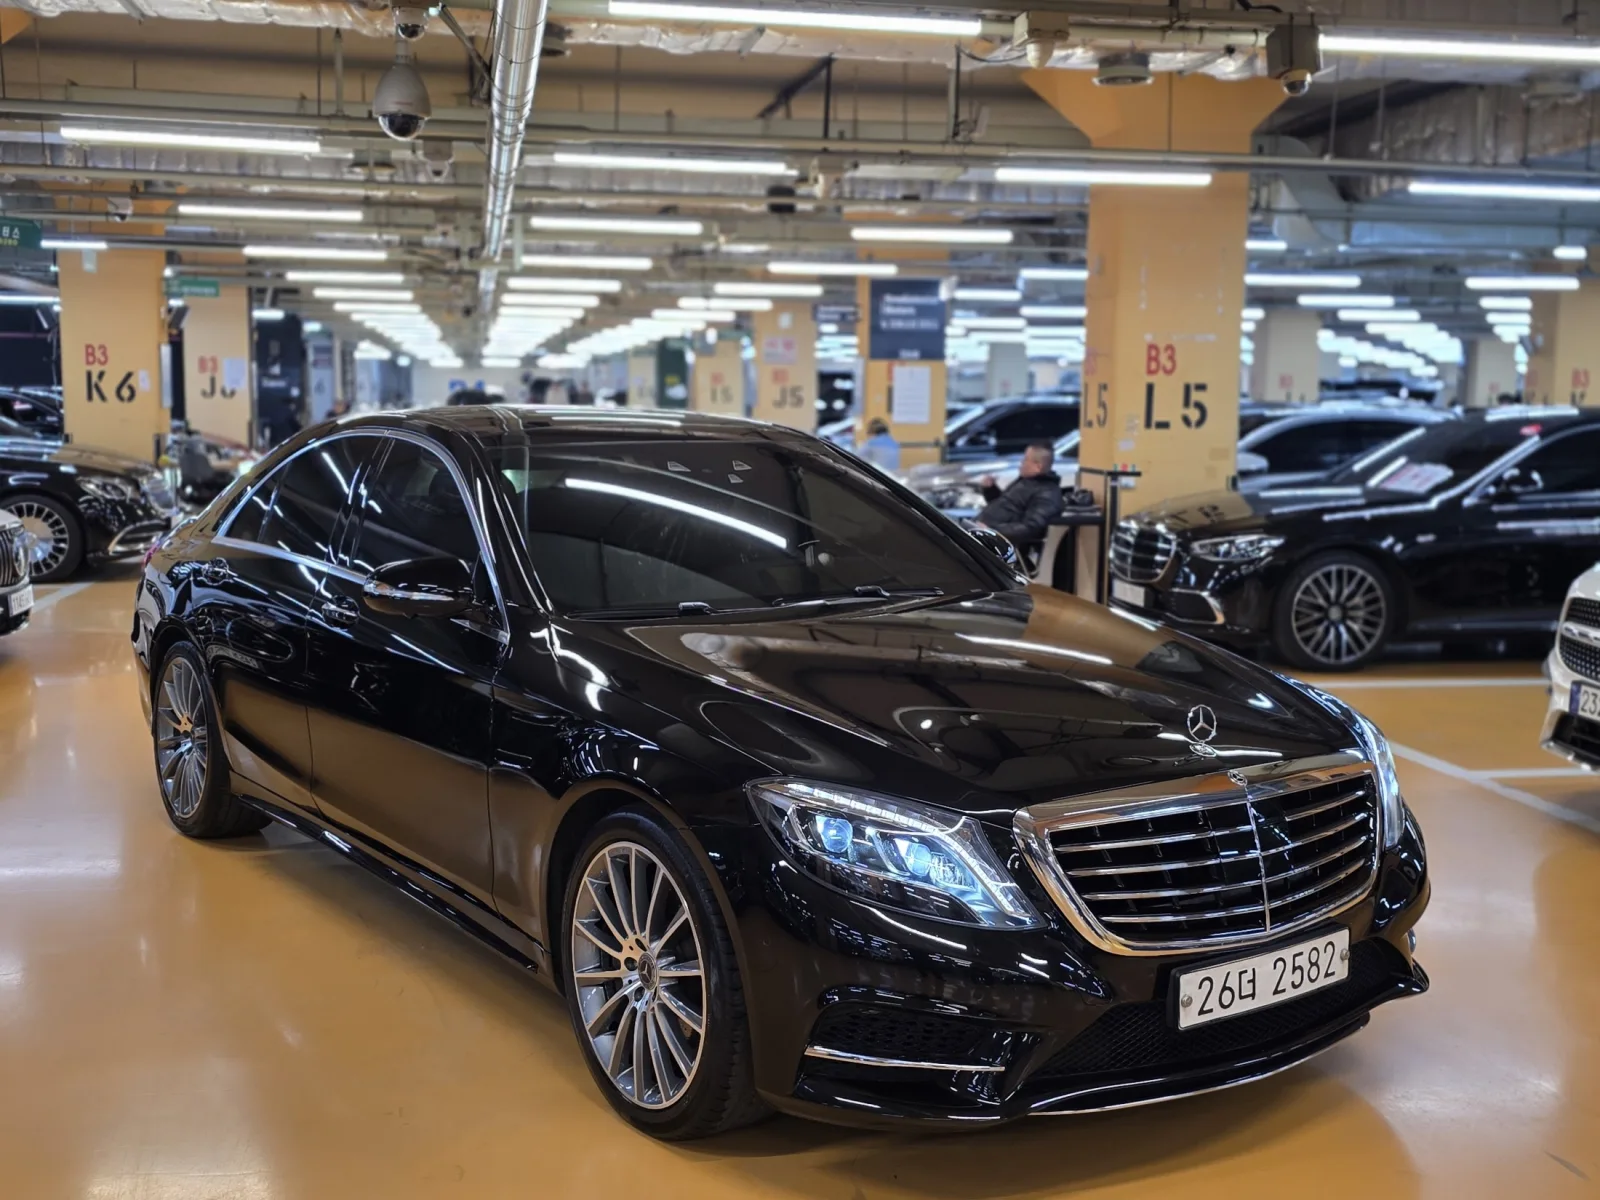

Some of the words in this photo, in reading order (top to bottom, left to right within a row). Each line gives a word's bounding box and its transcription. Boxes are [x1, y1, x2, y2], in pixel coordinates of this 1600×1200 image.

[85, 344, 109, 366] B3
[1146, 343, 1176, 376] B3
[1581, 690, 1600, 717] 23
[1197, 967, 1256, 1016] 26더
[1273, 941, 1336, 996] 2582
